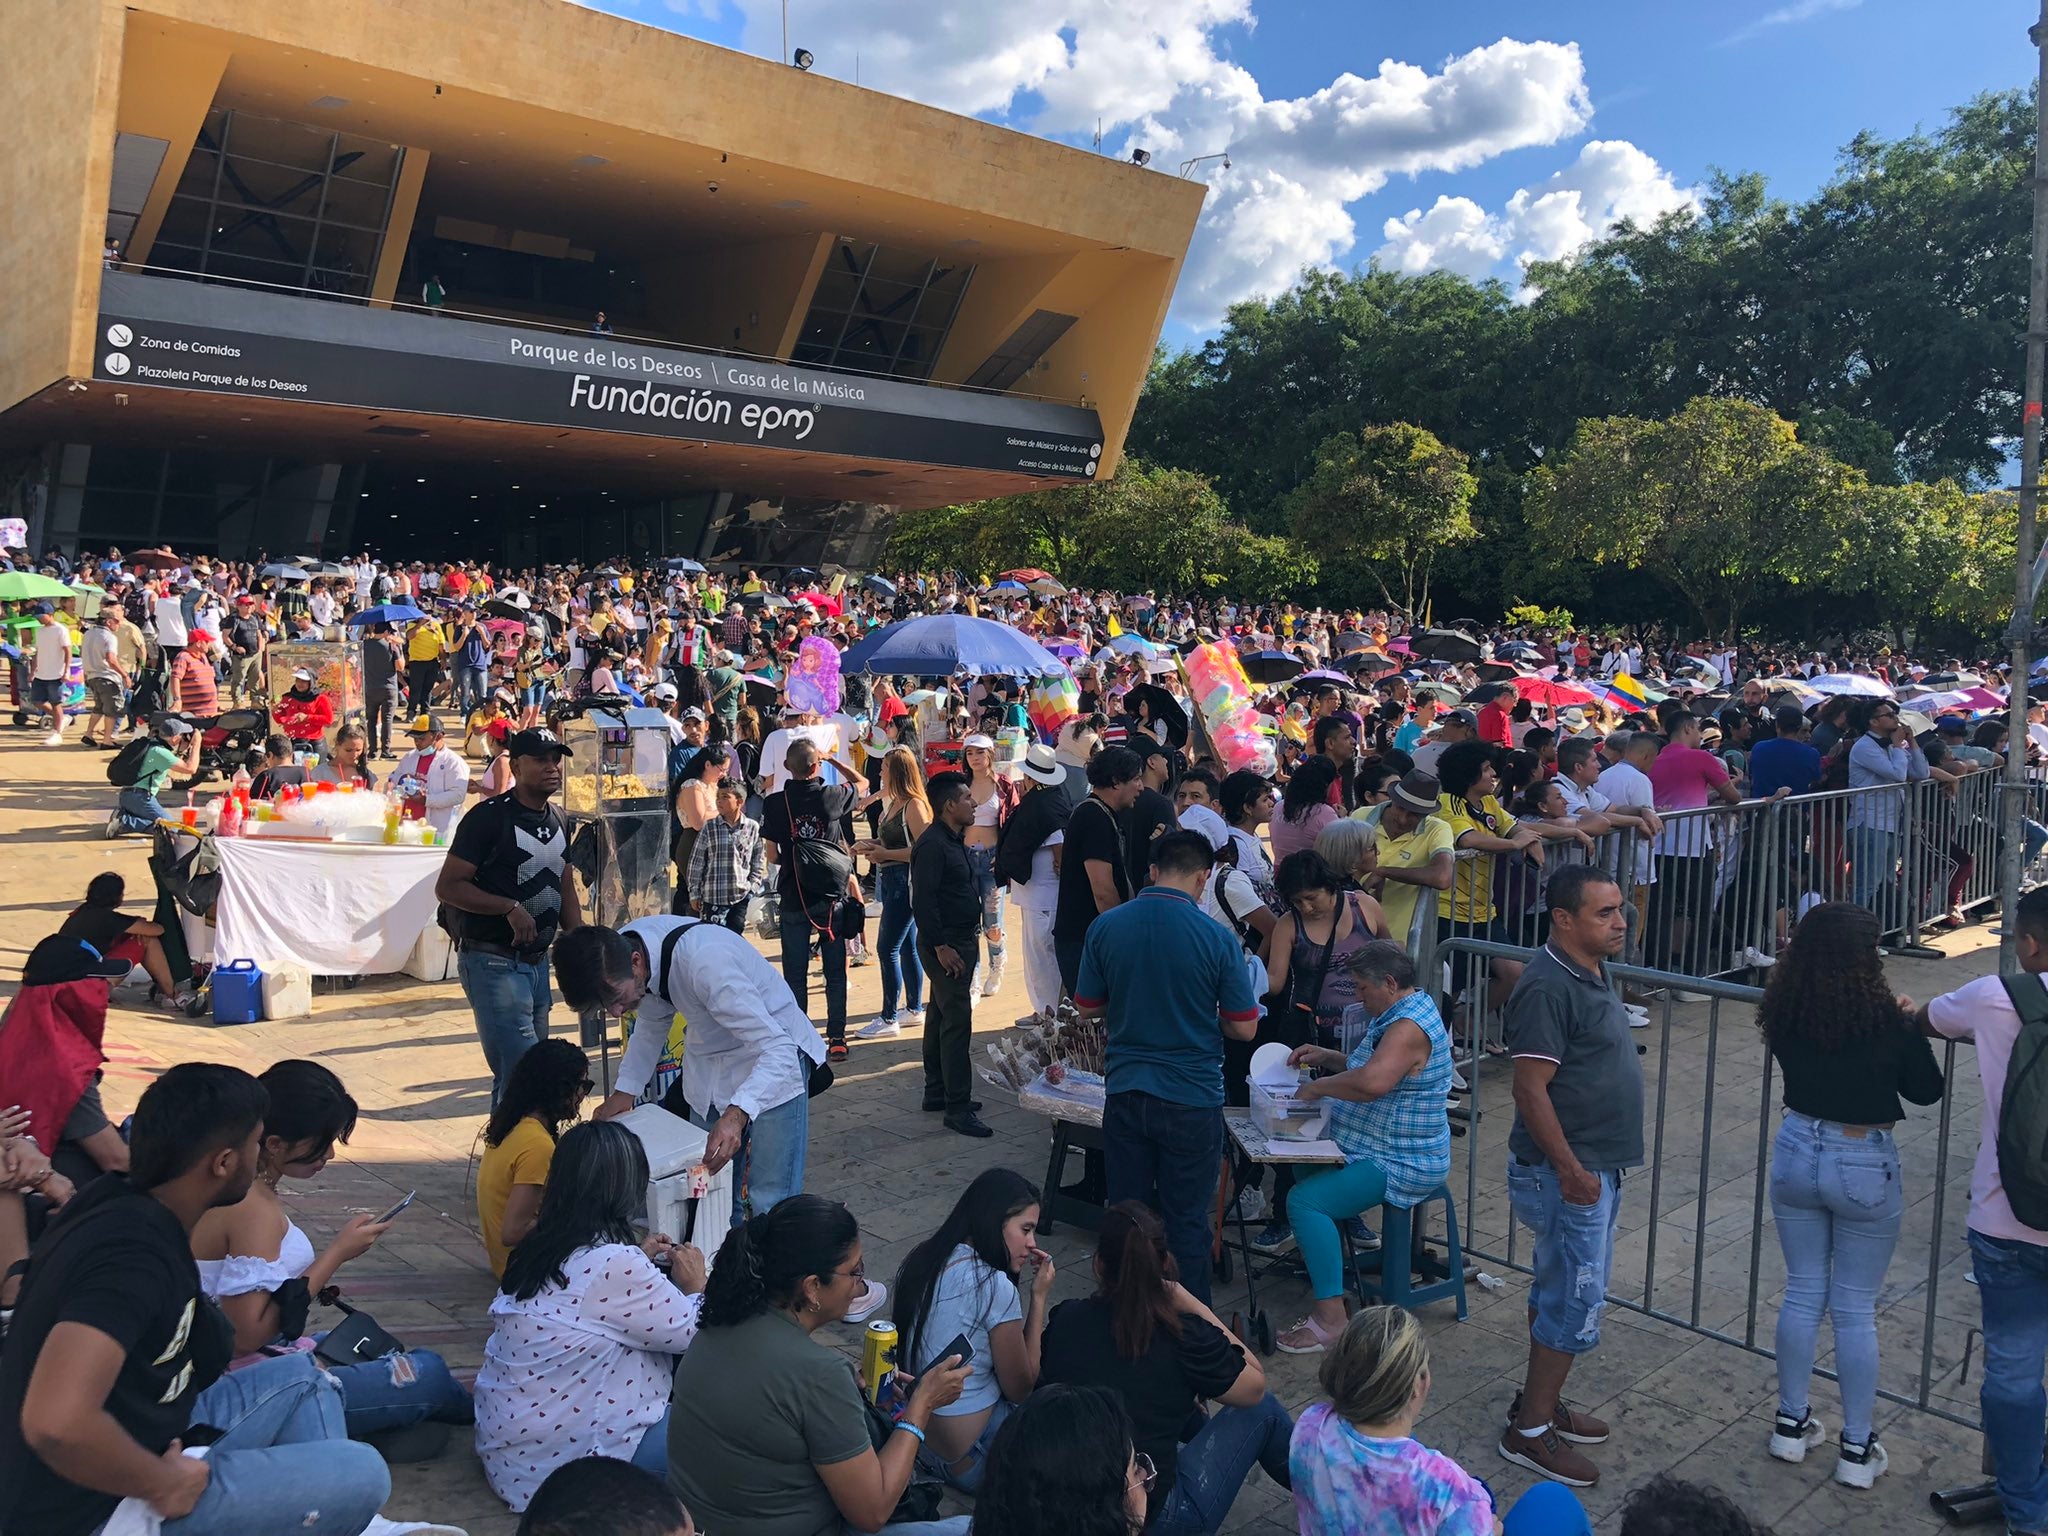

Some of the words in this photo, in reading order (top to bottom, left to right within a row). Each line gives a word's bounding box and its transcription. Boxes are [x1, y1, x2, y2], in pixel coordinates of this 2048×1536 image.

[140, 336, 171, 350] Zona
[173, 340, 189, 352] de
[191, 342, 241, 358] Comidas
[137, 365, 190, 382] Plazoleta
[192, 371, 232, 387] Parque
[235, 375, 249, 387] de
[251, 377, 267, 389] los
[269, 379, 308, 393] Deseos
[510, 338, 579, 365] Parque
[584, 348, 606, 366] de
[611, 351, 637, 370] los
[642, 356, 702, 379] Deseos
[728, 369, 766, 388] Casa
[770, 374, 790, 391] de
[794, 377, 808, 394] la
[812, 380, 865, 401] Música
[570, 374, 732, 424] Fundación
[740, 403, 814, 440] epm
[1006, 437, 1027, 447] Salones
[1028, 440, 1035, 448] de
[1036, 441, 1054, 450] Música
[1070, 446, 1077, 454] de
[1018, 459, 1037, 468] Acceso
[1038, 461, 1051, 470] Casa
[1051, 462, 1059, 470] de
